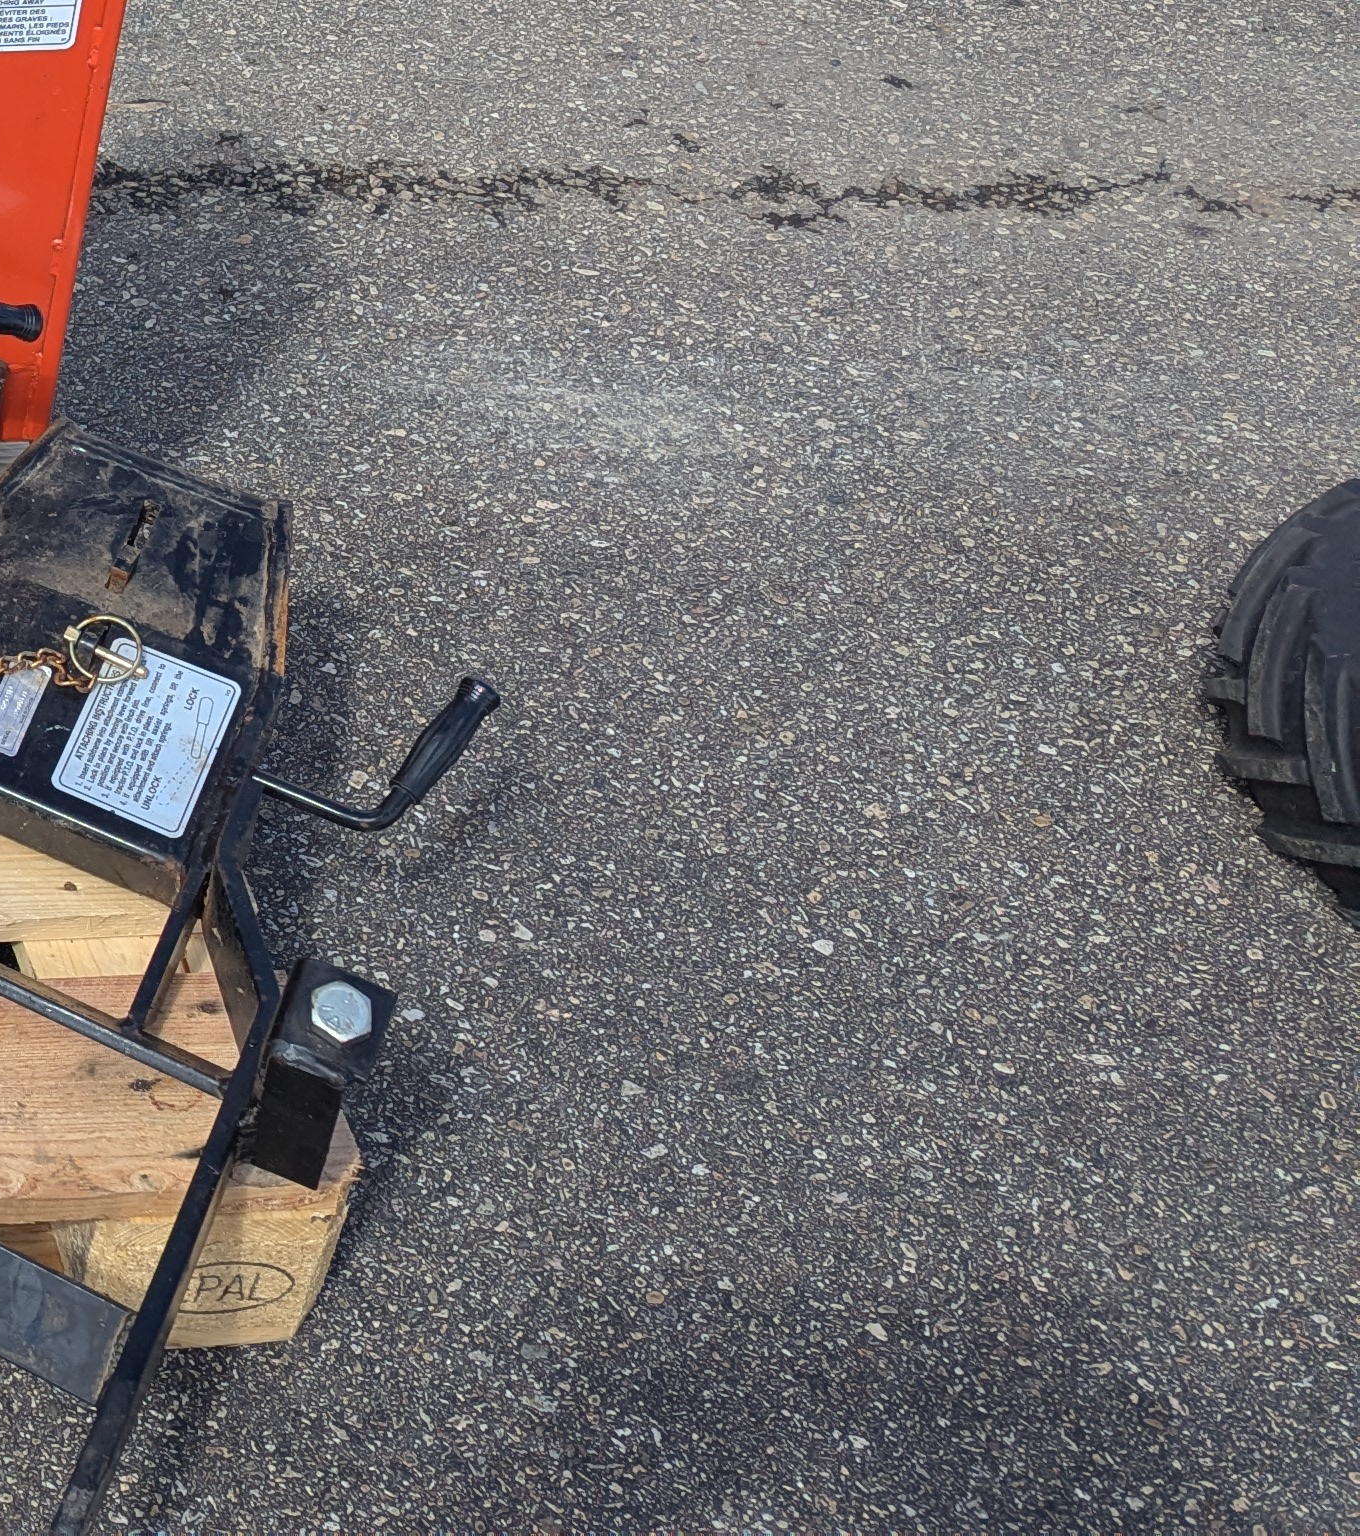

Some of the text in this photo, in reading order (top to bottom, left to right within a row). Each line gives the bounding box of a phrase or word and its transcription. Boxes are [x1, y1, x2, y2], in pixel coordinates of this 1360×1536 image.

[26, 28, 66, 36] ÉLOIGNÉS
[184, 687, 200, 711] LOCK
[74, 720, 98, 761] ATTACHING
[141, 775, 163, 810] UNLOCK
[182, 1272, 267, 1304] PAL
